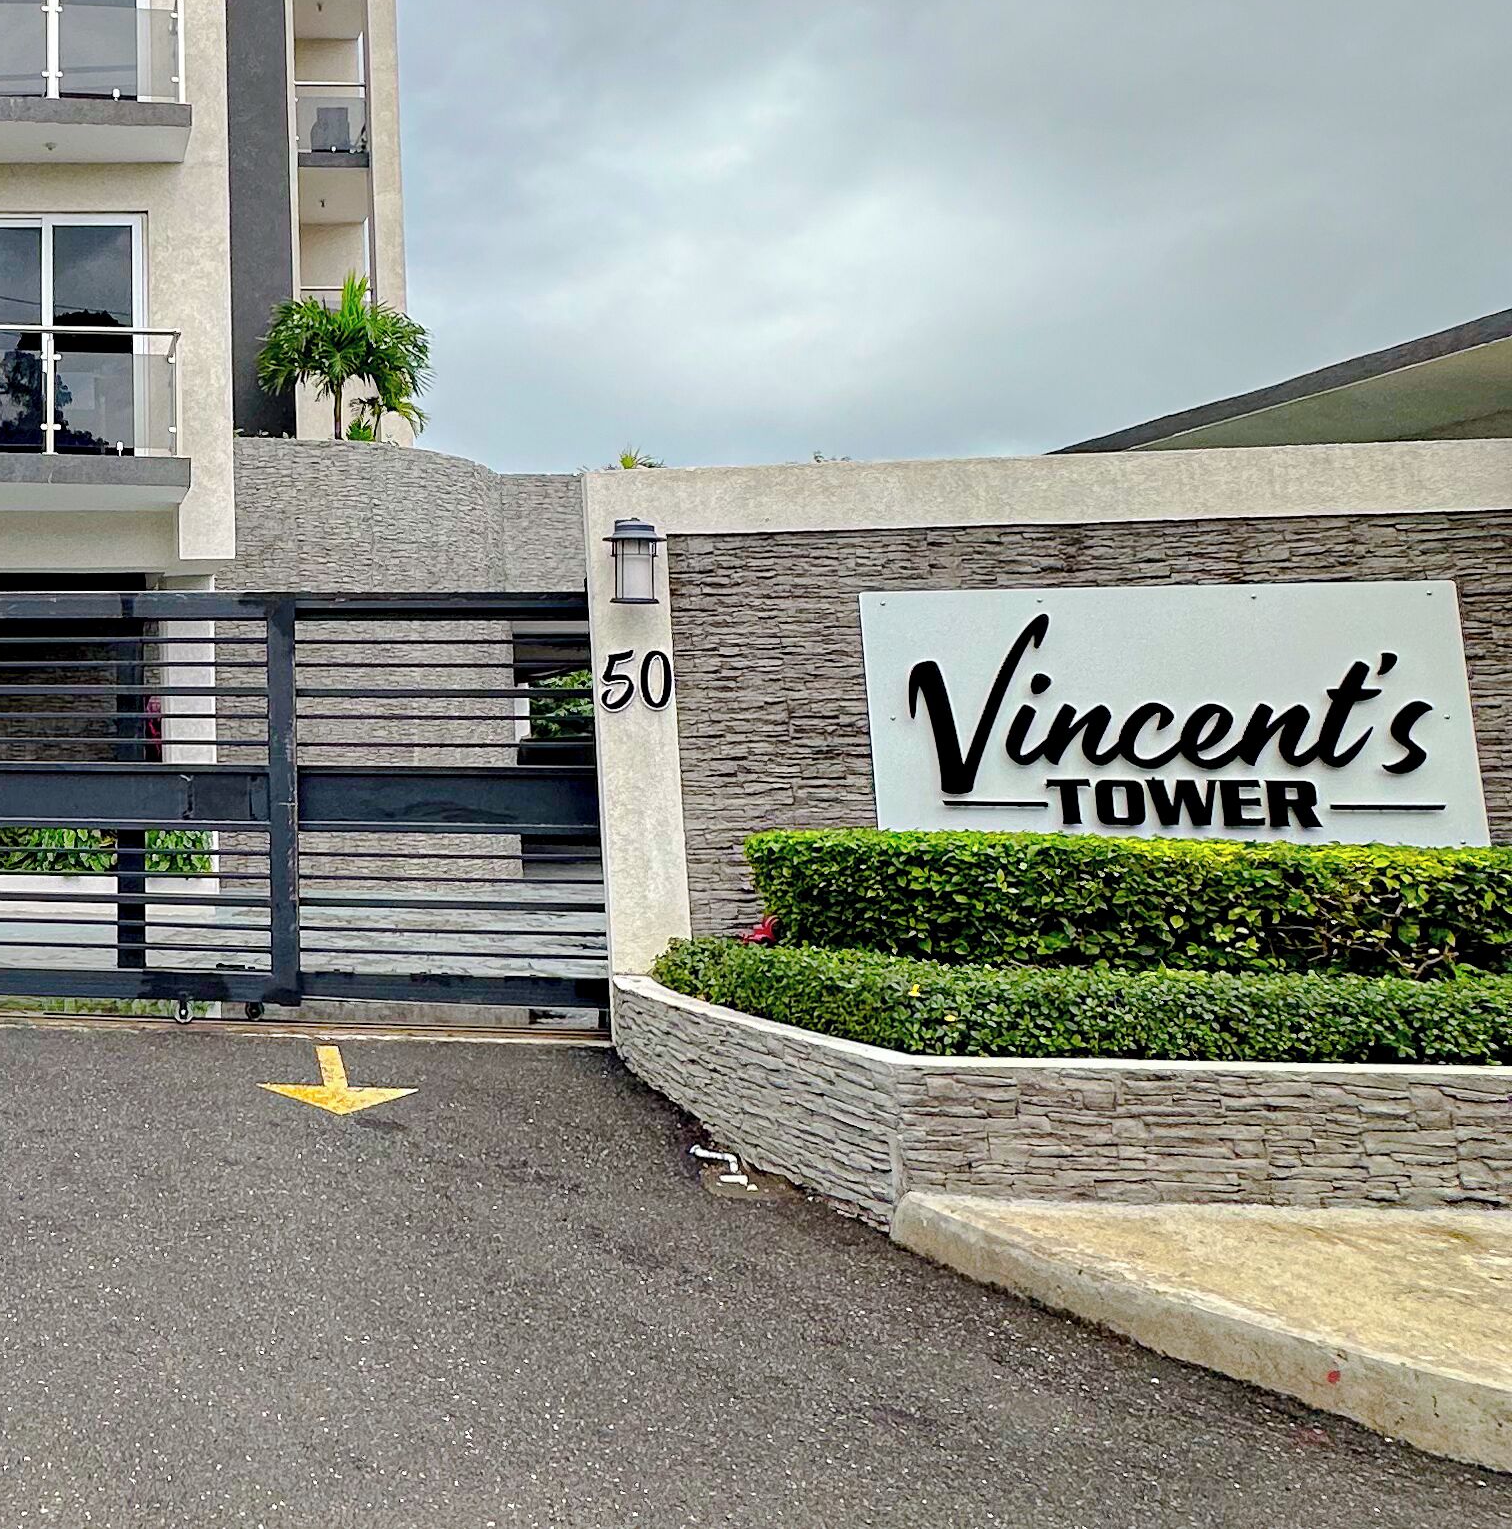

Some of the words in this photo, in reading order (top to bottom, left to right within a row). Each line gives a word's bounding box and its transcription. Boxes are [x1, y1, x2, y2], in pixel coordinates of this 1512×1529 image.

[600, 648, 674, 712] 50
[908, 613, 1434, 795] Vincent's
[1045, 777, 1323, 830] TOWER
